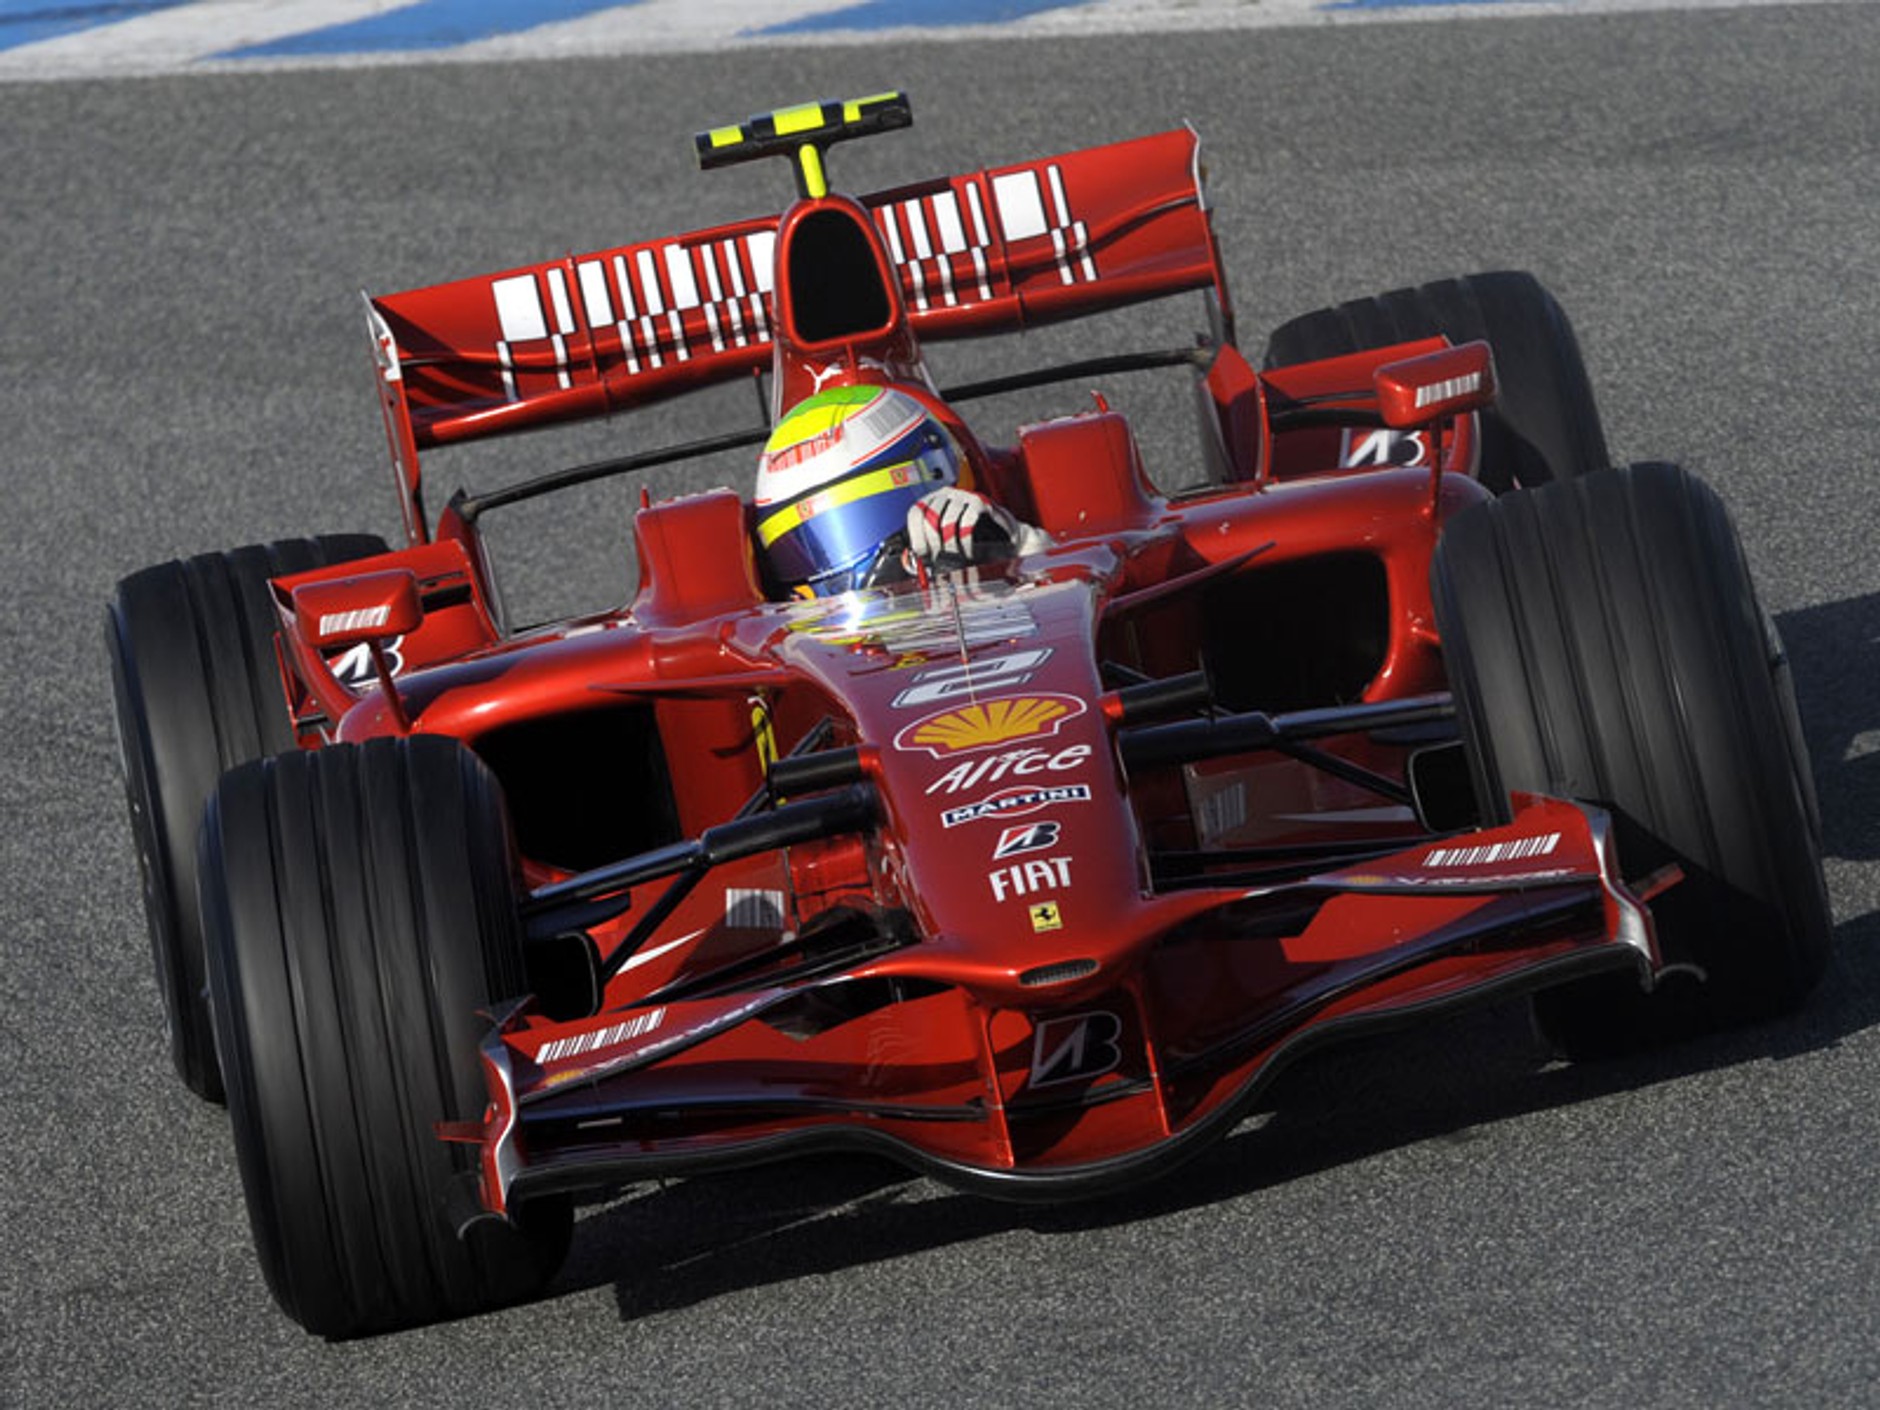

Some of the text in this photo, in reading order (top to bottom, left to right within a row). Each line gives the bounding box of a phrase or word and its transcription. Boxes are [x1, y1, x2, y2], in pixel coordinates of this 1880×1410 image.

[925, 744, 1092, 795] Alice
[949, 784, 1082, 823] MARTINI
[989, 856, 1073, 903] FIAT
